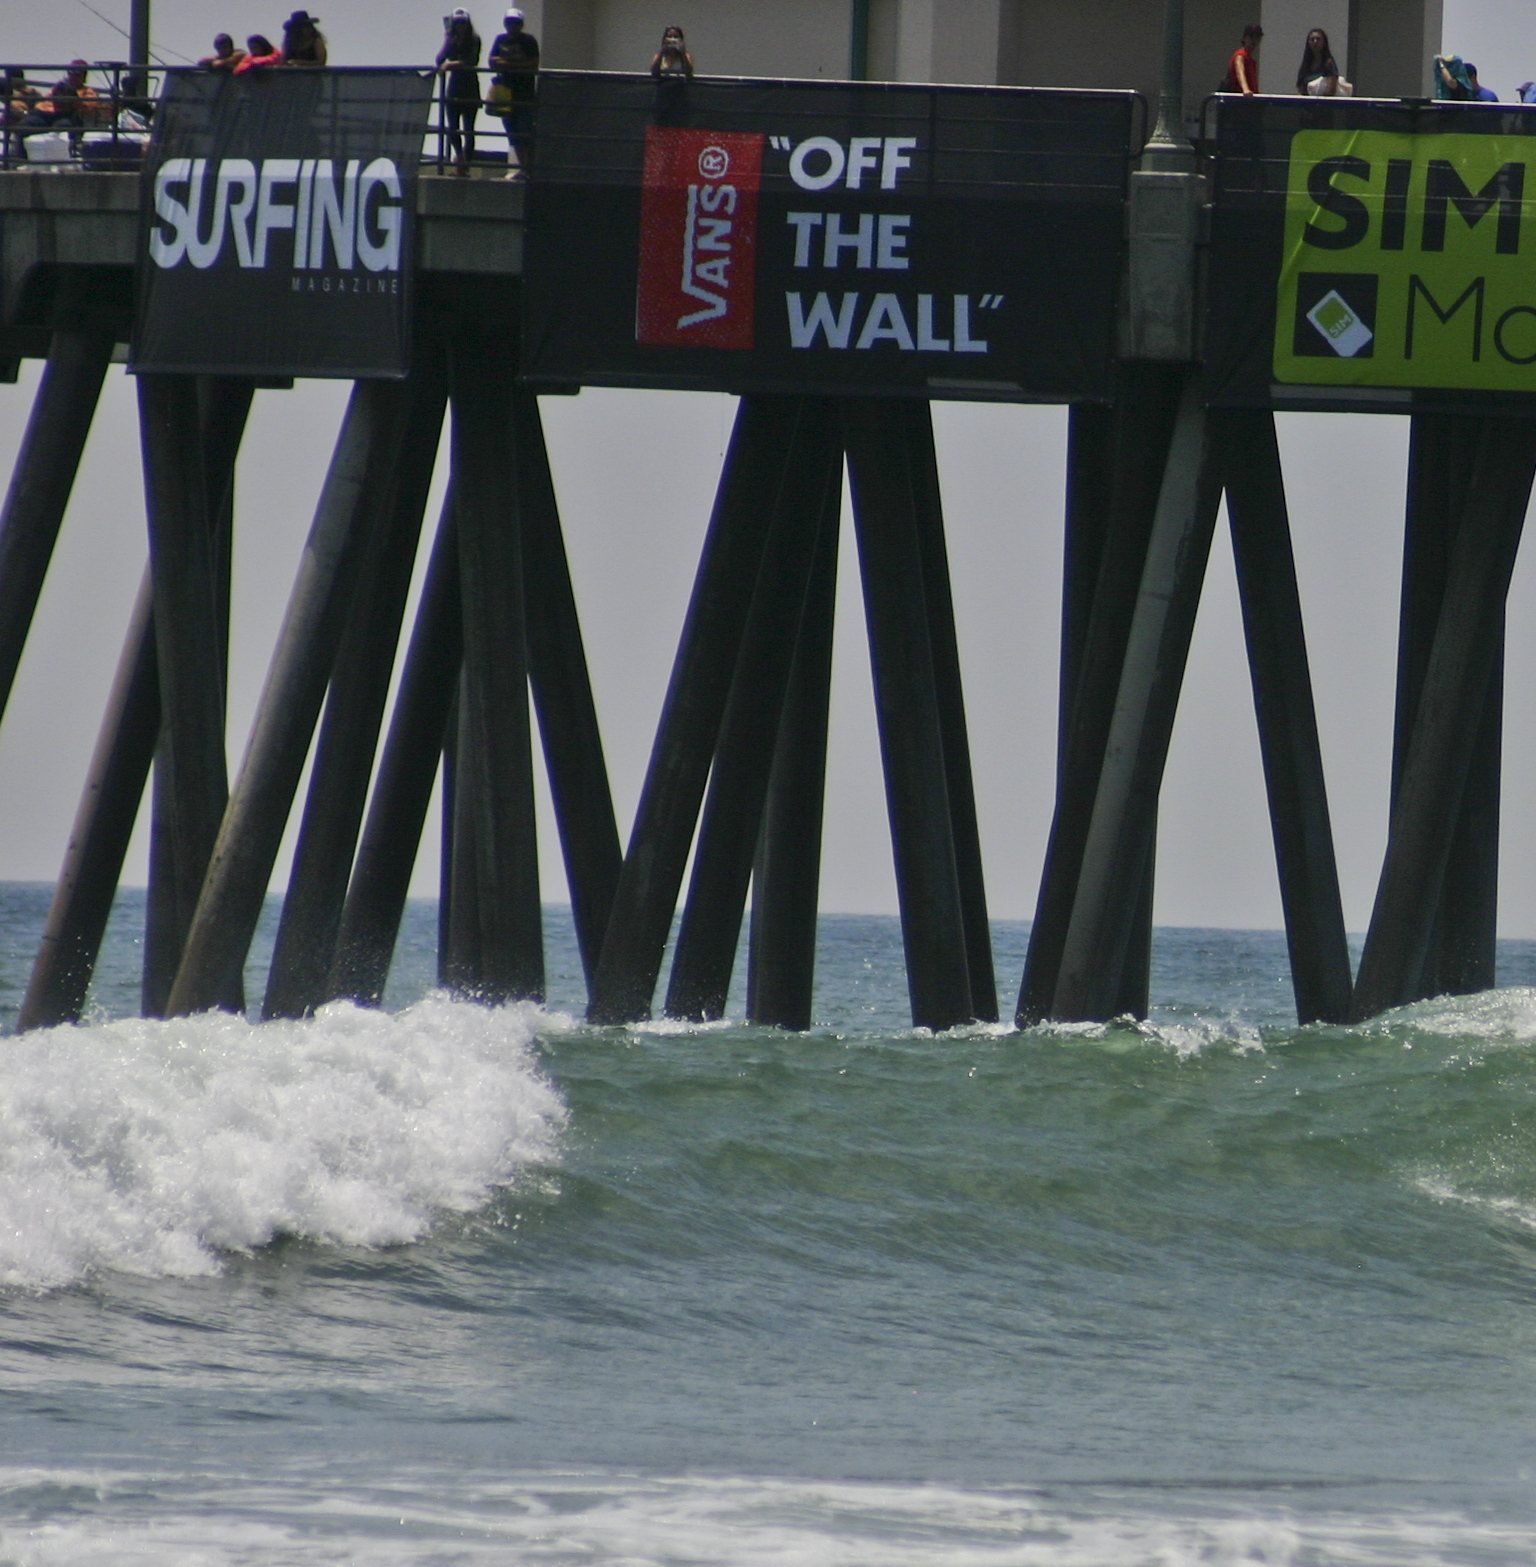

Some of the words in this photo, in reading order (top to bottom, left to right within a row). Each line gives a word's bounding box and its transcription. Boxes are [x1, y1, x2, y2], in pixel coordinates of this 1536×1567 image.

[149, 157, 403, 272] SURFING
[786, 211, 911, 269] THE
[291, 276, 399, 295] MAGAZINE
[1328, 313, 1353, 338] SIM
